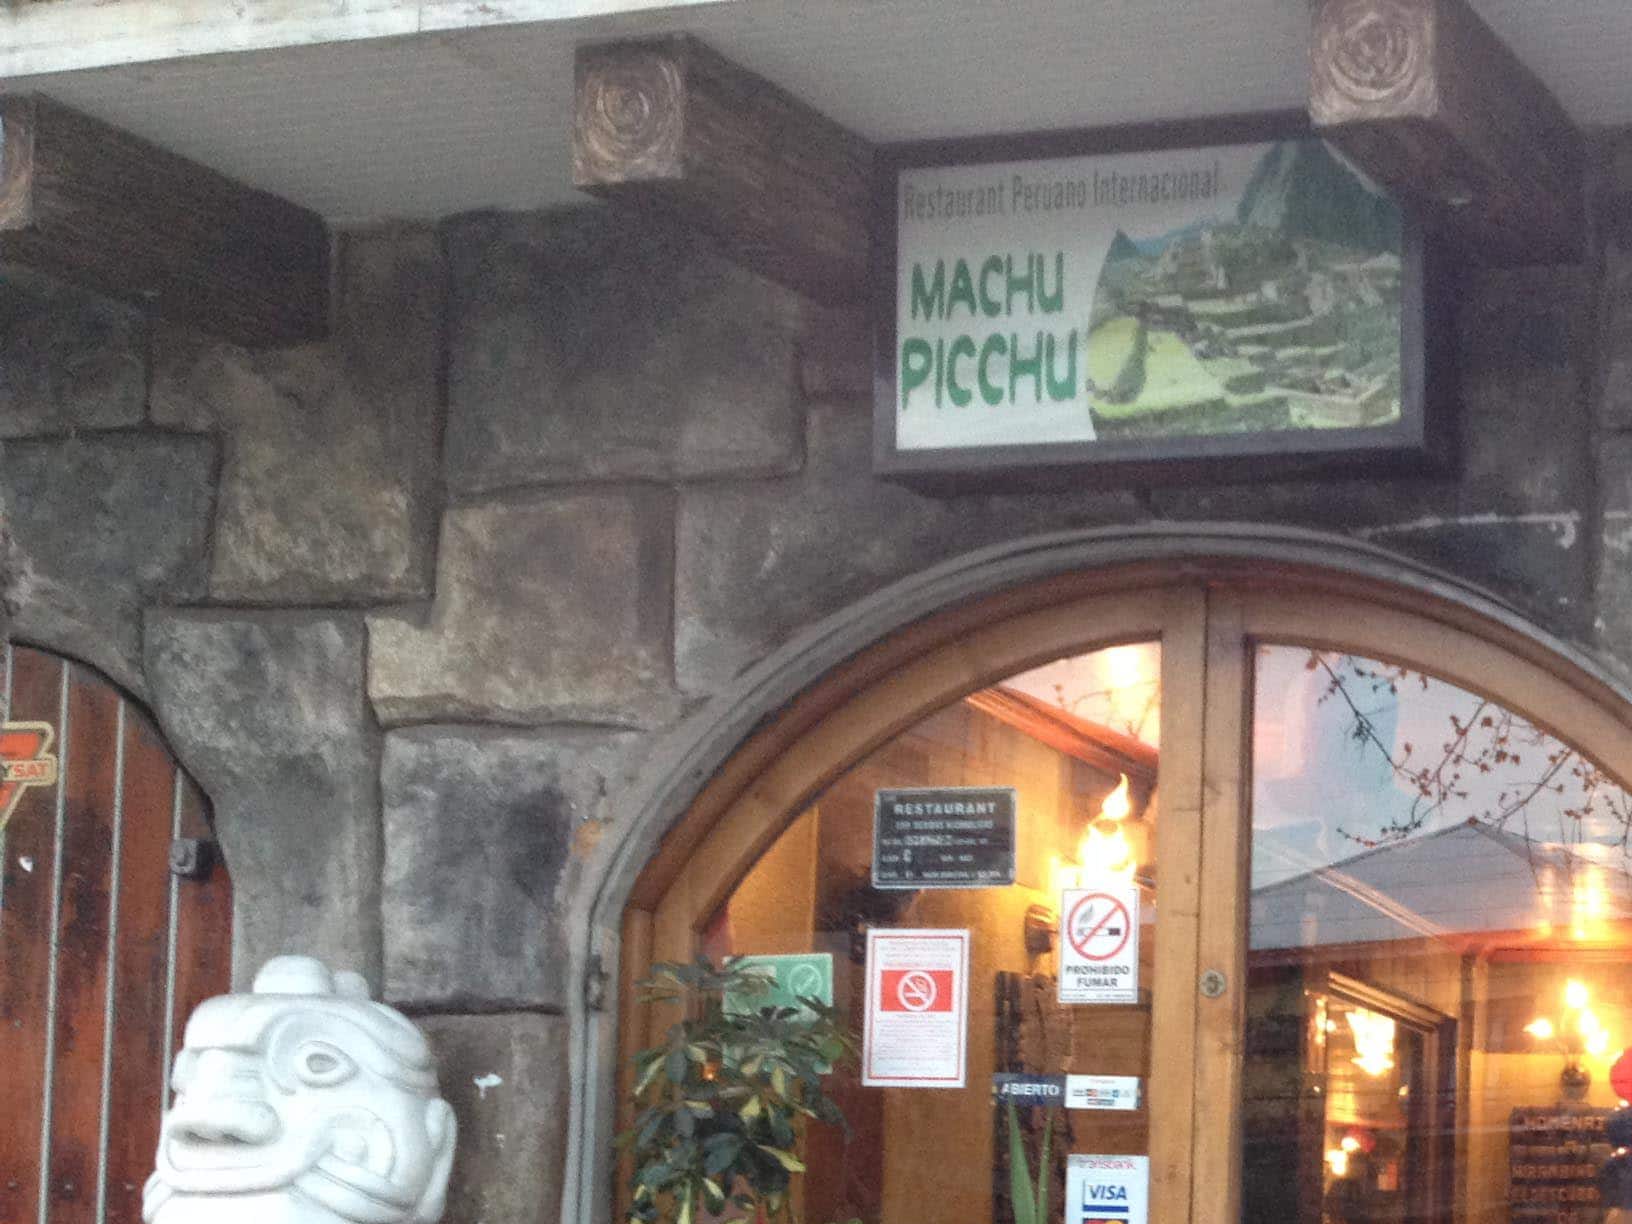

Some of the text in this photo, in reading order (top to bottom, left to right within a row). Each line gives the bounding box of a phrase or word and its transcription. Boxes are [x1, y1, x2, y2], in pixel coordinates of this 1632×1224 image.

[904, 163, 1220, 220] Restaurant Peruano Internacional
[911, 250, 1065, 321] MACHU
[901, 330, 1078, 411] PICCHU
[893, 801, 996, 815] RESTAURANT
[1065, 964, 1130, 976] PROHIBIDO
[1076, 977, 1119, 988] FUMAR
[1001, 1083, 1060, 1096] ABIERTO
[1088, 1184, 1128, 1200] VISA
